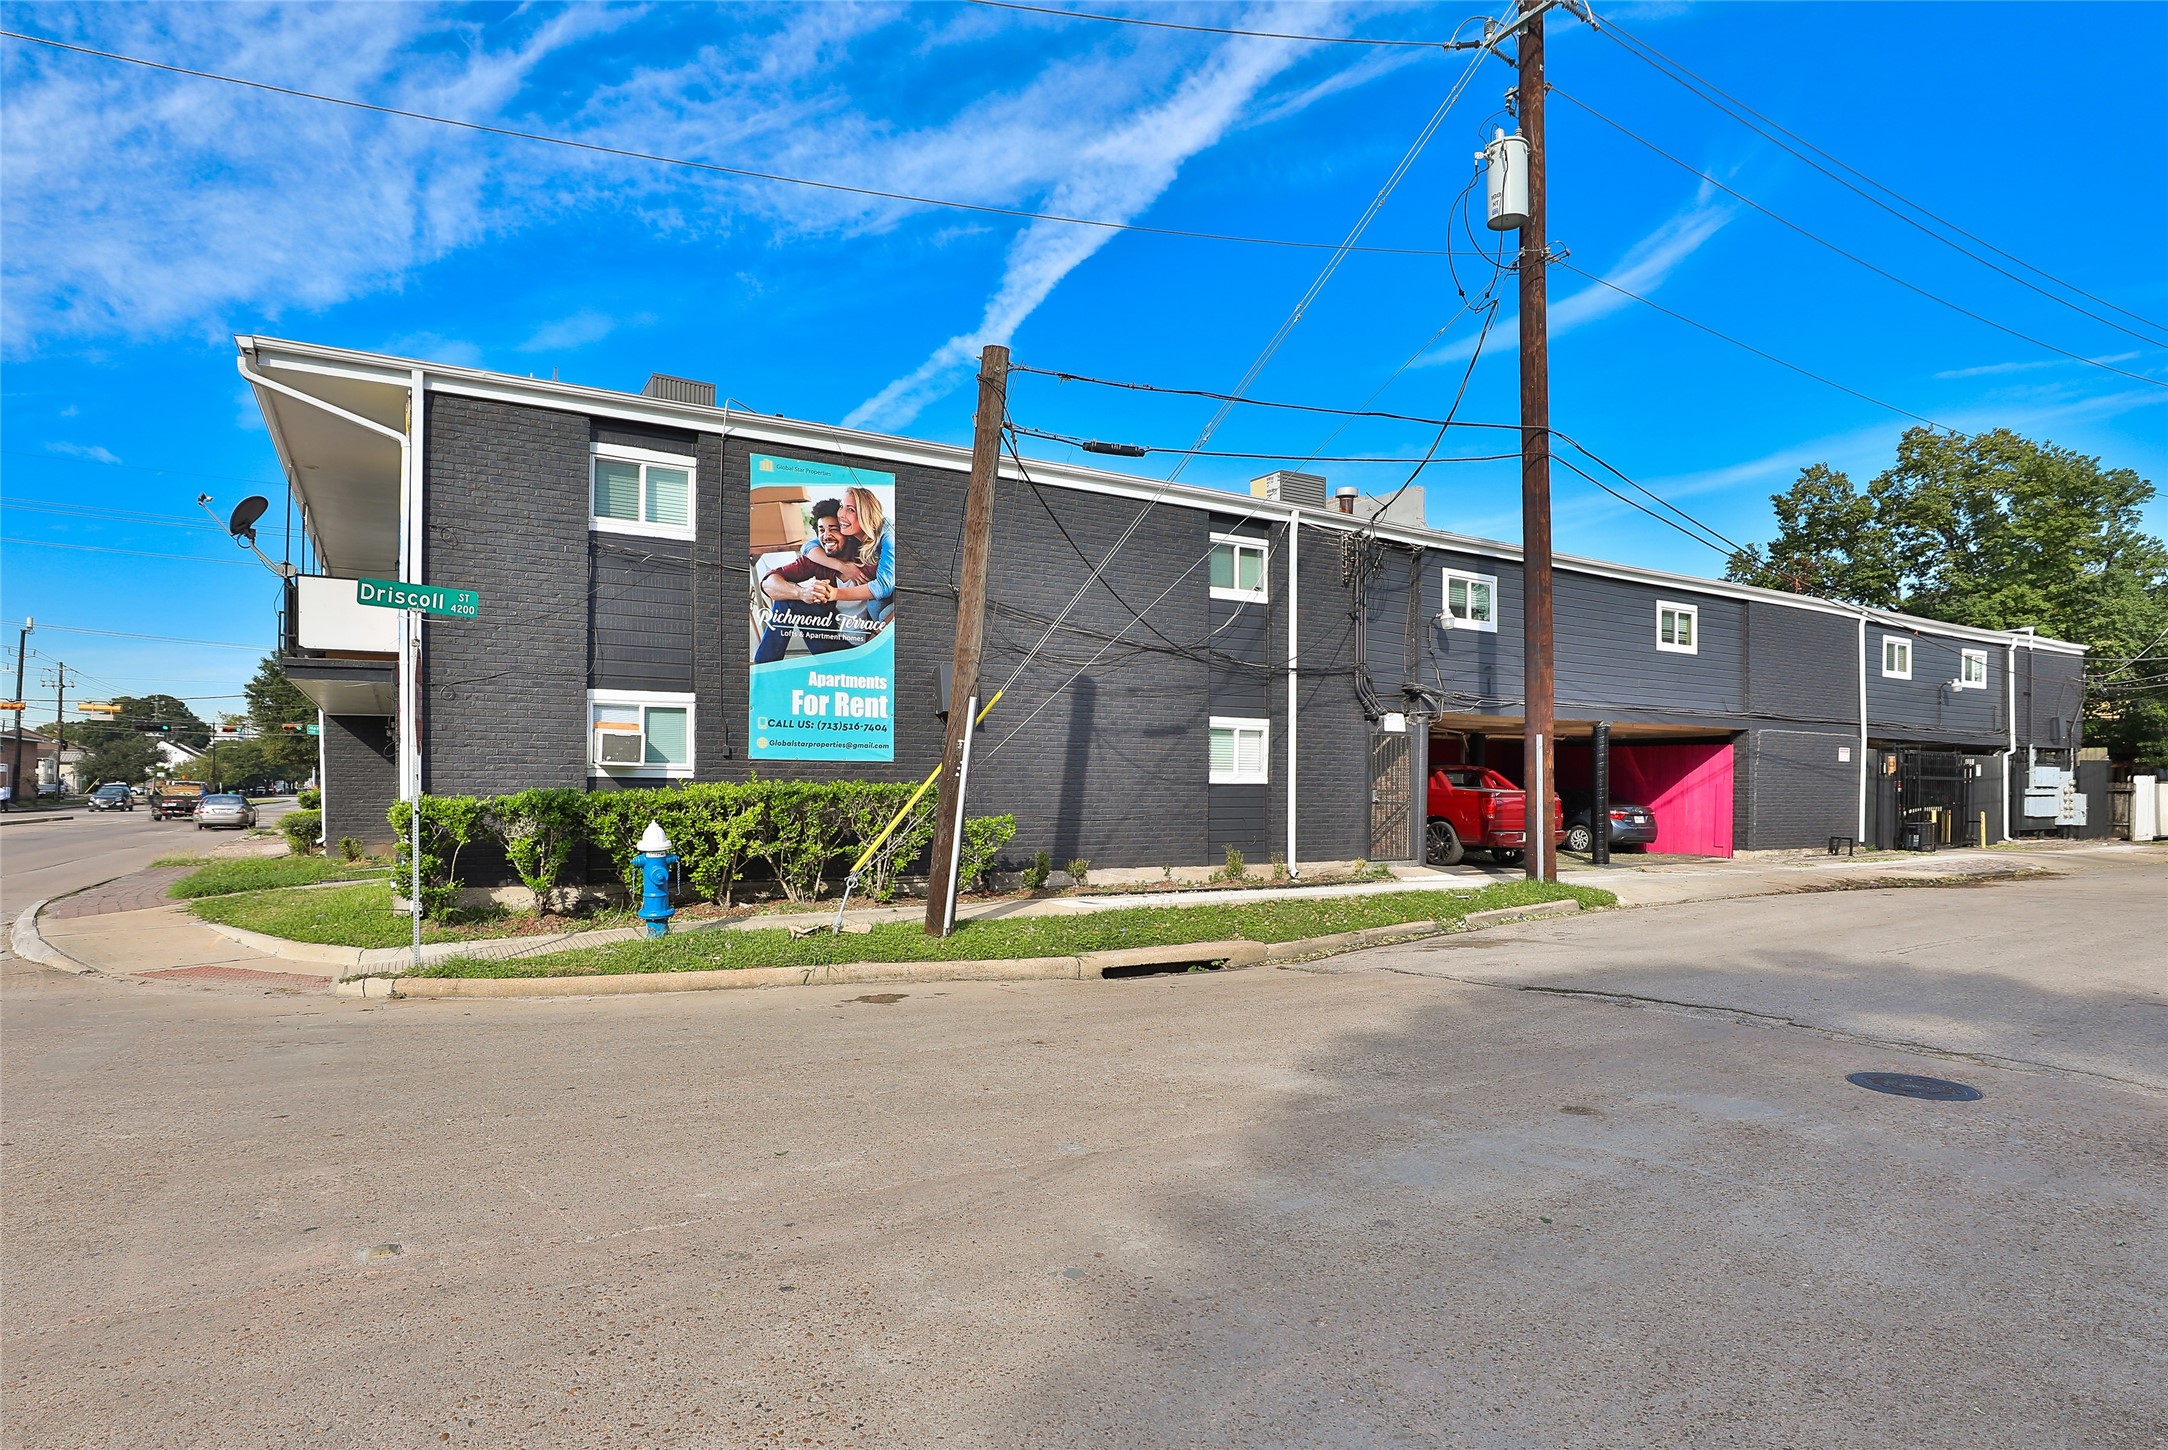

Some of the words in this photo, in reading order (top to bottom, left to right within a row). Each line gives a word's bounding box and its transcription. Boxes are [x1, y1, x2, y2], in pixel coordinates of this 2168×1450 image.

[805, 468, 832, 477] Properties
[360, 583, 444, 609] Driscoll
[458, 593, 470, 603] ST
[450, 604, 475, 615] 4200
[757, 607, 833, 631] Richmond
[835, 613, 886, 632] Terrace
[780, 629, 798, 638] Lofts
[799, 631, 805, 639] &
[805, 631, 841, 641] Apartment
[842, 634, 864, 642] homes
[808, 671, 887, 690] Apartments
[791, 689, 829, 716] For
[835, 691, 888, 718] Rent
[767, 719, 794, 728] CALL
[797, 720, 815, 729] US:
[817, 720, 888, 732] (713)516-7404
[769, 739, 889, 749] Globalstarproperties@gmail.com
